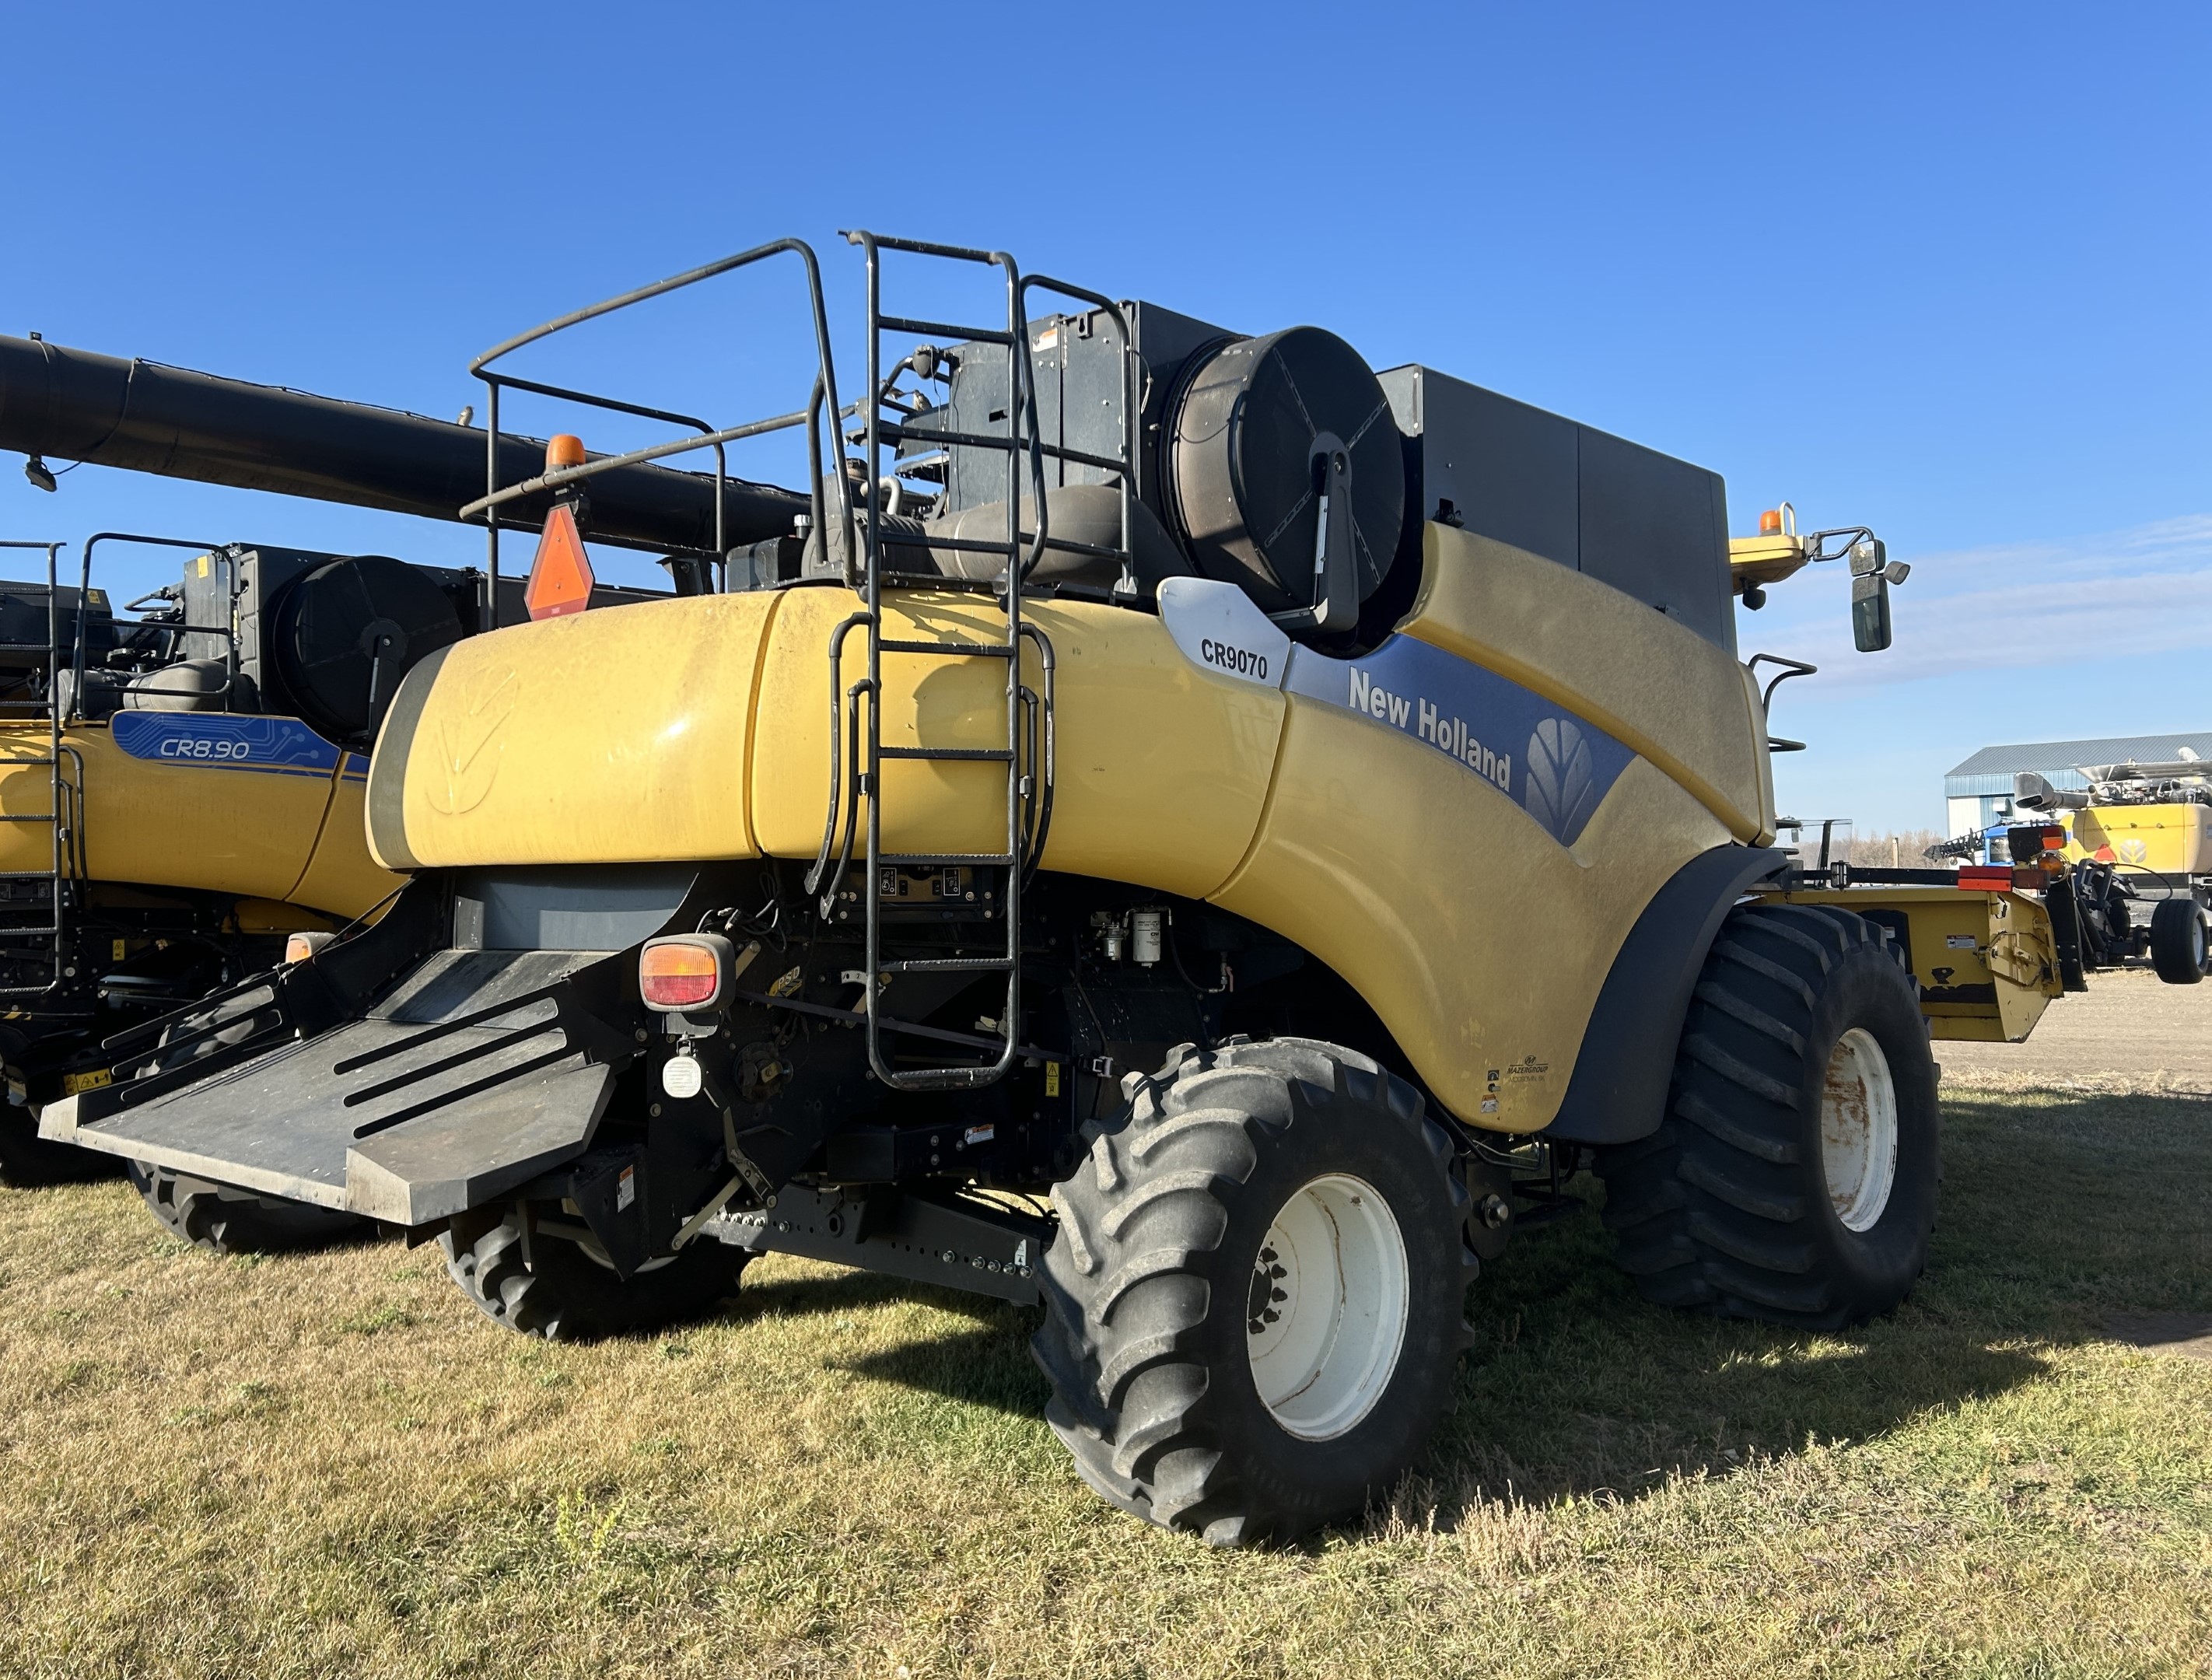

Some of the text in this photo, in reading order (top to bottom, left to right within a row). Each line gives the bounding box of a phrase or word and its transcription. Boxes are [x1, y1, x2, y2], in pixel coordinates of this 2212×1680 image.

[1201, 639, 1268, 680] CR9070
[1349, 666, 1511, 793] New Holland
[160, 739, 250, 759] CR8.90
[778, 965, 800, 990] PSD
